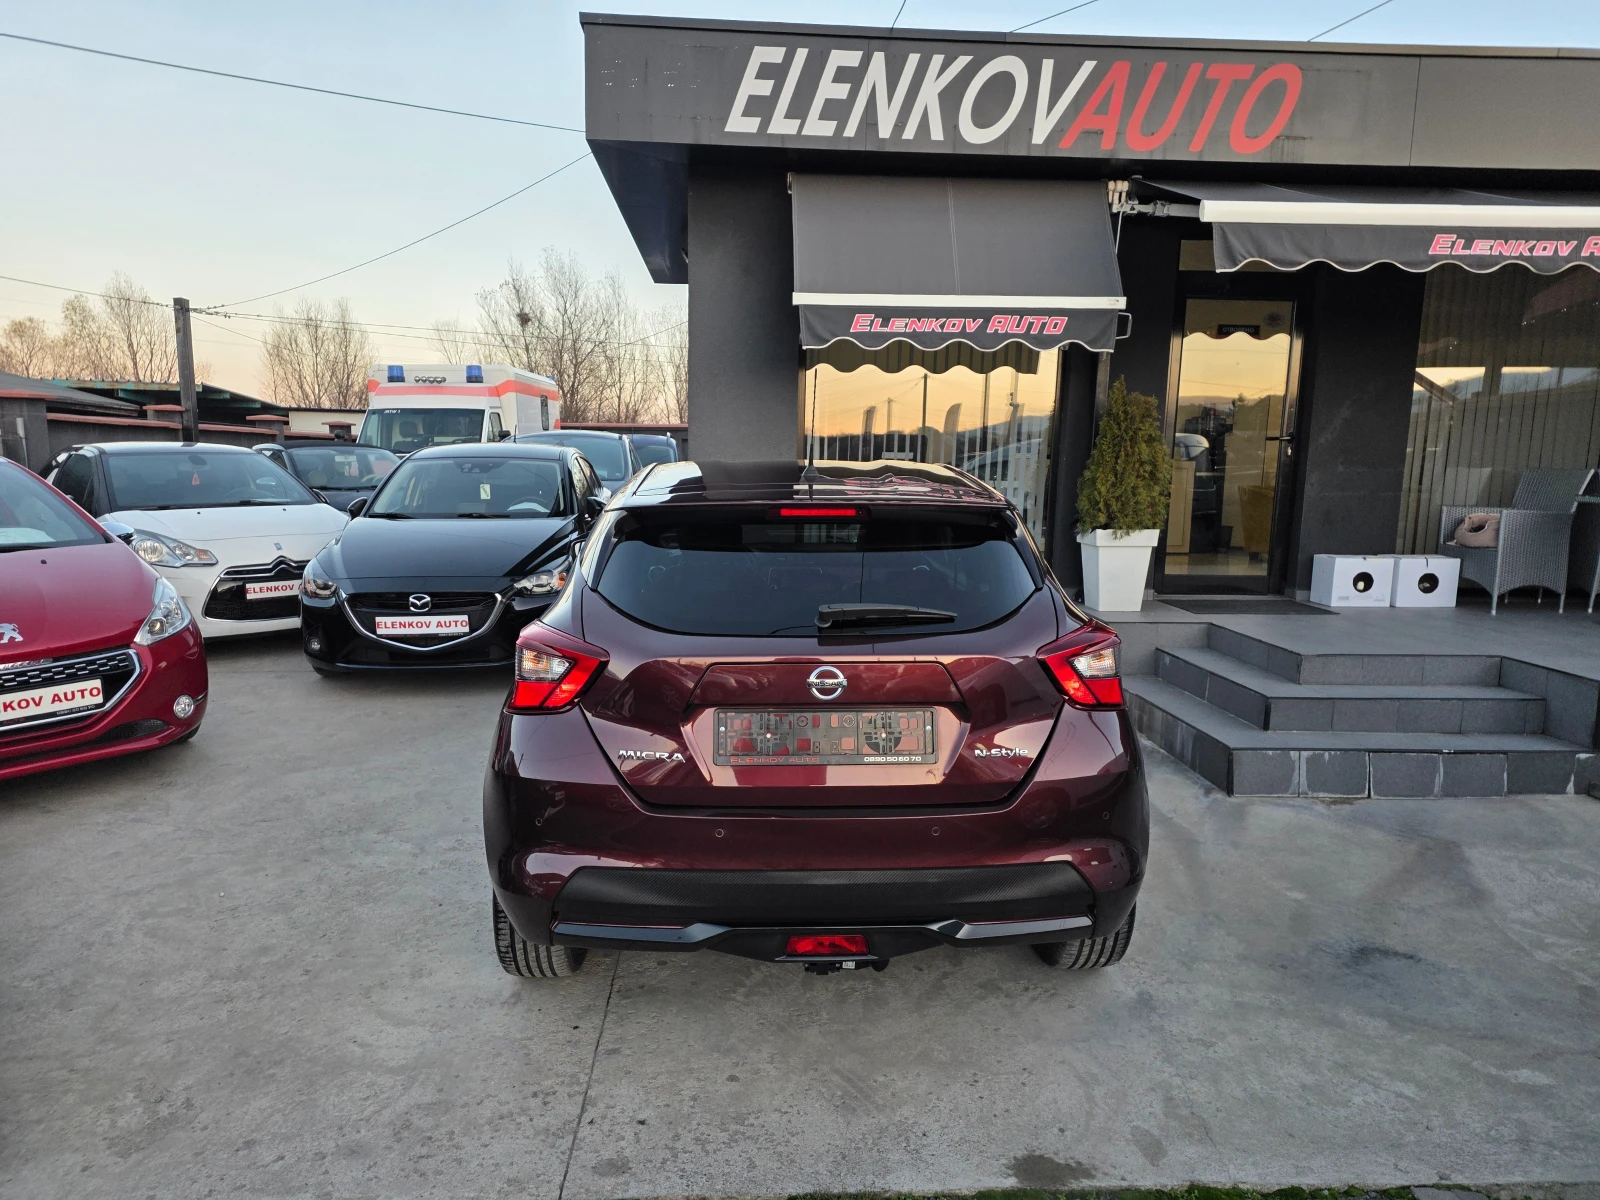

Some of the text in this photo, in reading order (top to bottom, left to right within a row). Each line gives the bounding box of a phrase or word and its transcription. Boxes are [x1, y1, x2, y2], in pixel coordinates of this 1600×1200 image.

[1428, 233, 1578, 257] ELENKOV
[849, 313, 1068, 335] ELENKOV AUTO
[245, 584, 295, 595] ELENKOV
[376, 619, 469, 629] ELENKOV AUTO
[0, 695, 44, 713] KOV
[50, 686, 102, 705] AUTO
[617, 749, 686, 764] MICRA
[974, 747, 1029, 759] N-Style
